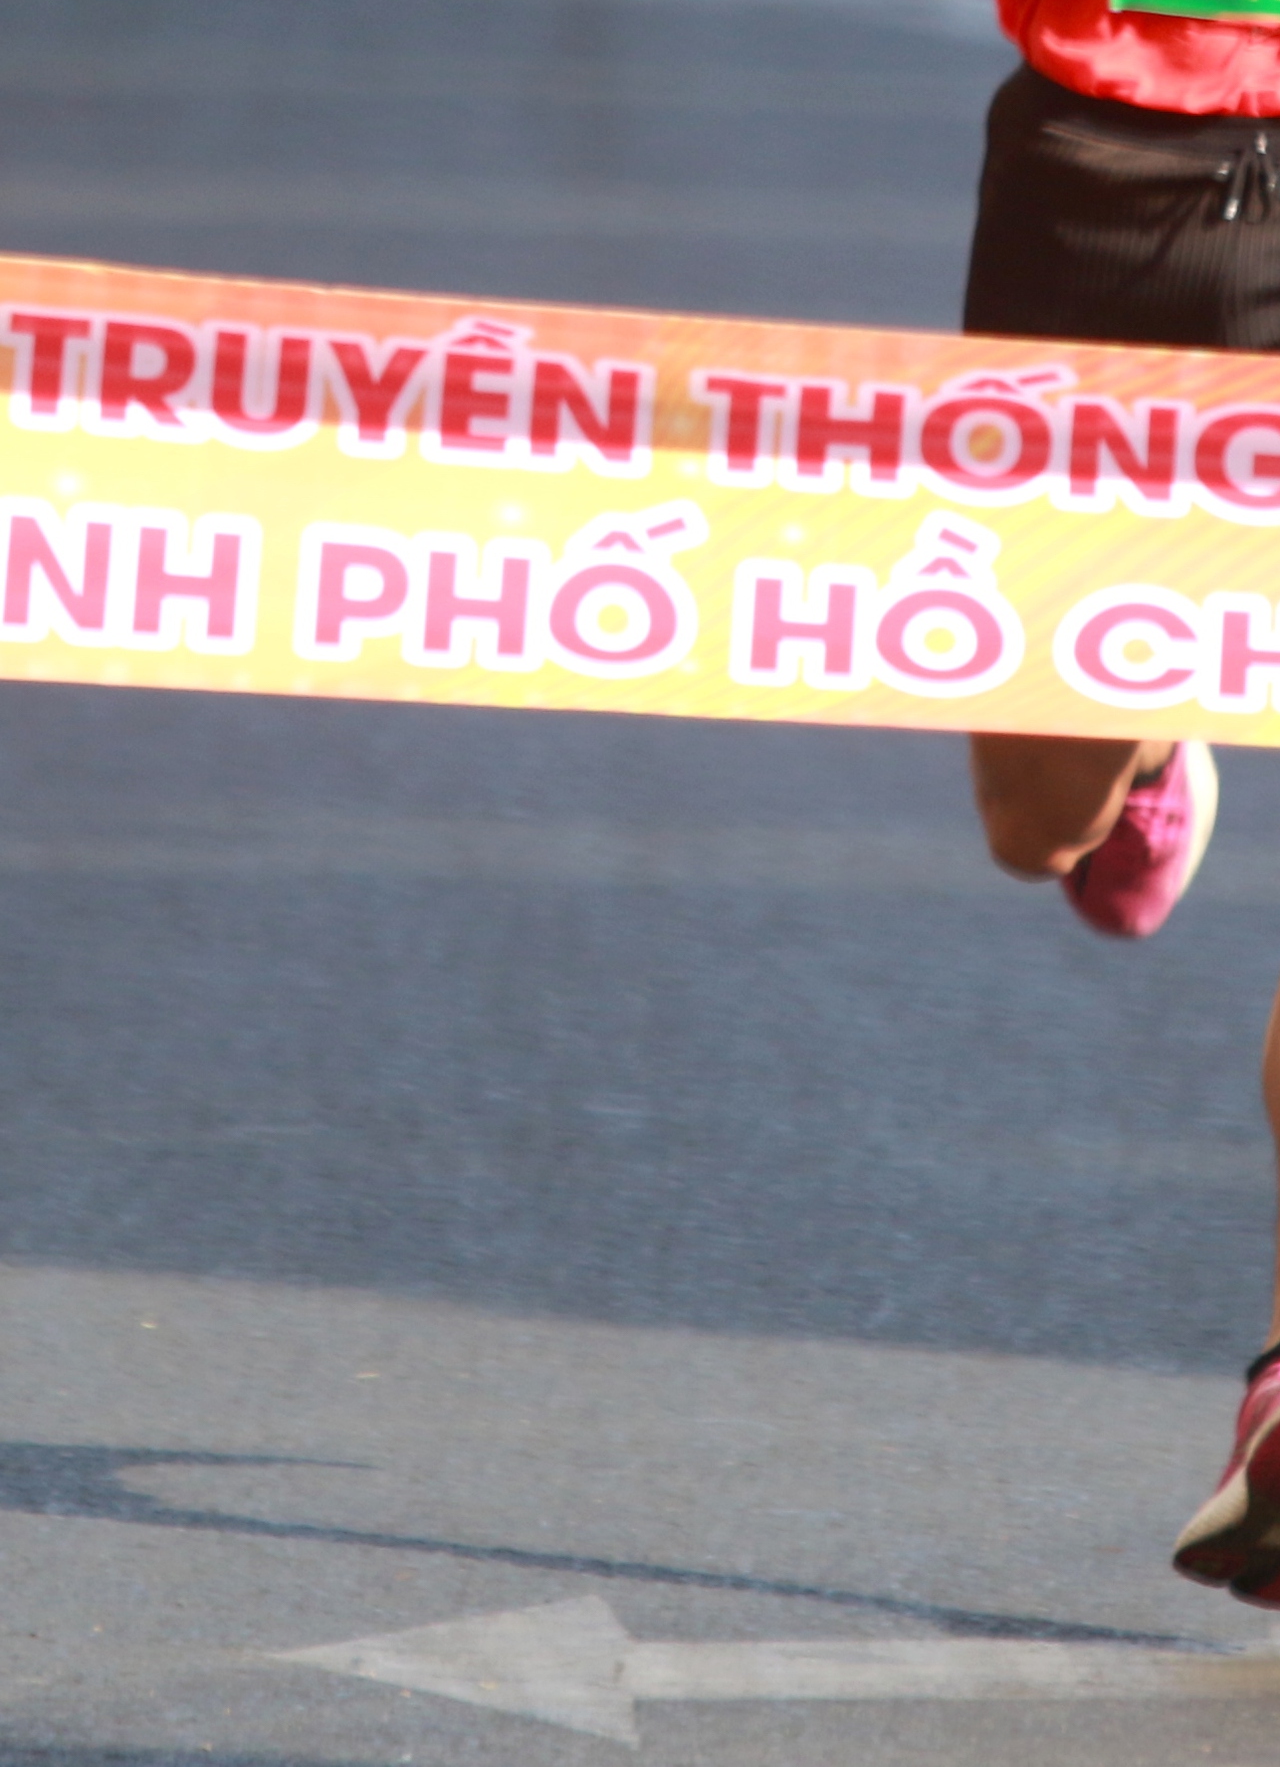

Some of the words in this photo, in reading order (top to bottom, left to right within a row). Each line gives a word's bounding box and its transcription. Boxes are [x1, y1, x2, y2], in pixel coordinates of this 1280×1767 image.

[10, 310, 641, 463] TRUYỀN
[315, 517, 687, 663] PHỐ
[750, 527, 1004, 683] HỒ
